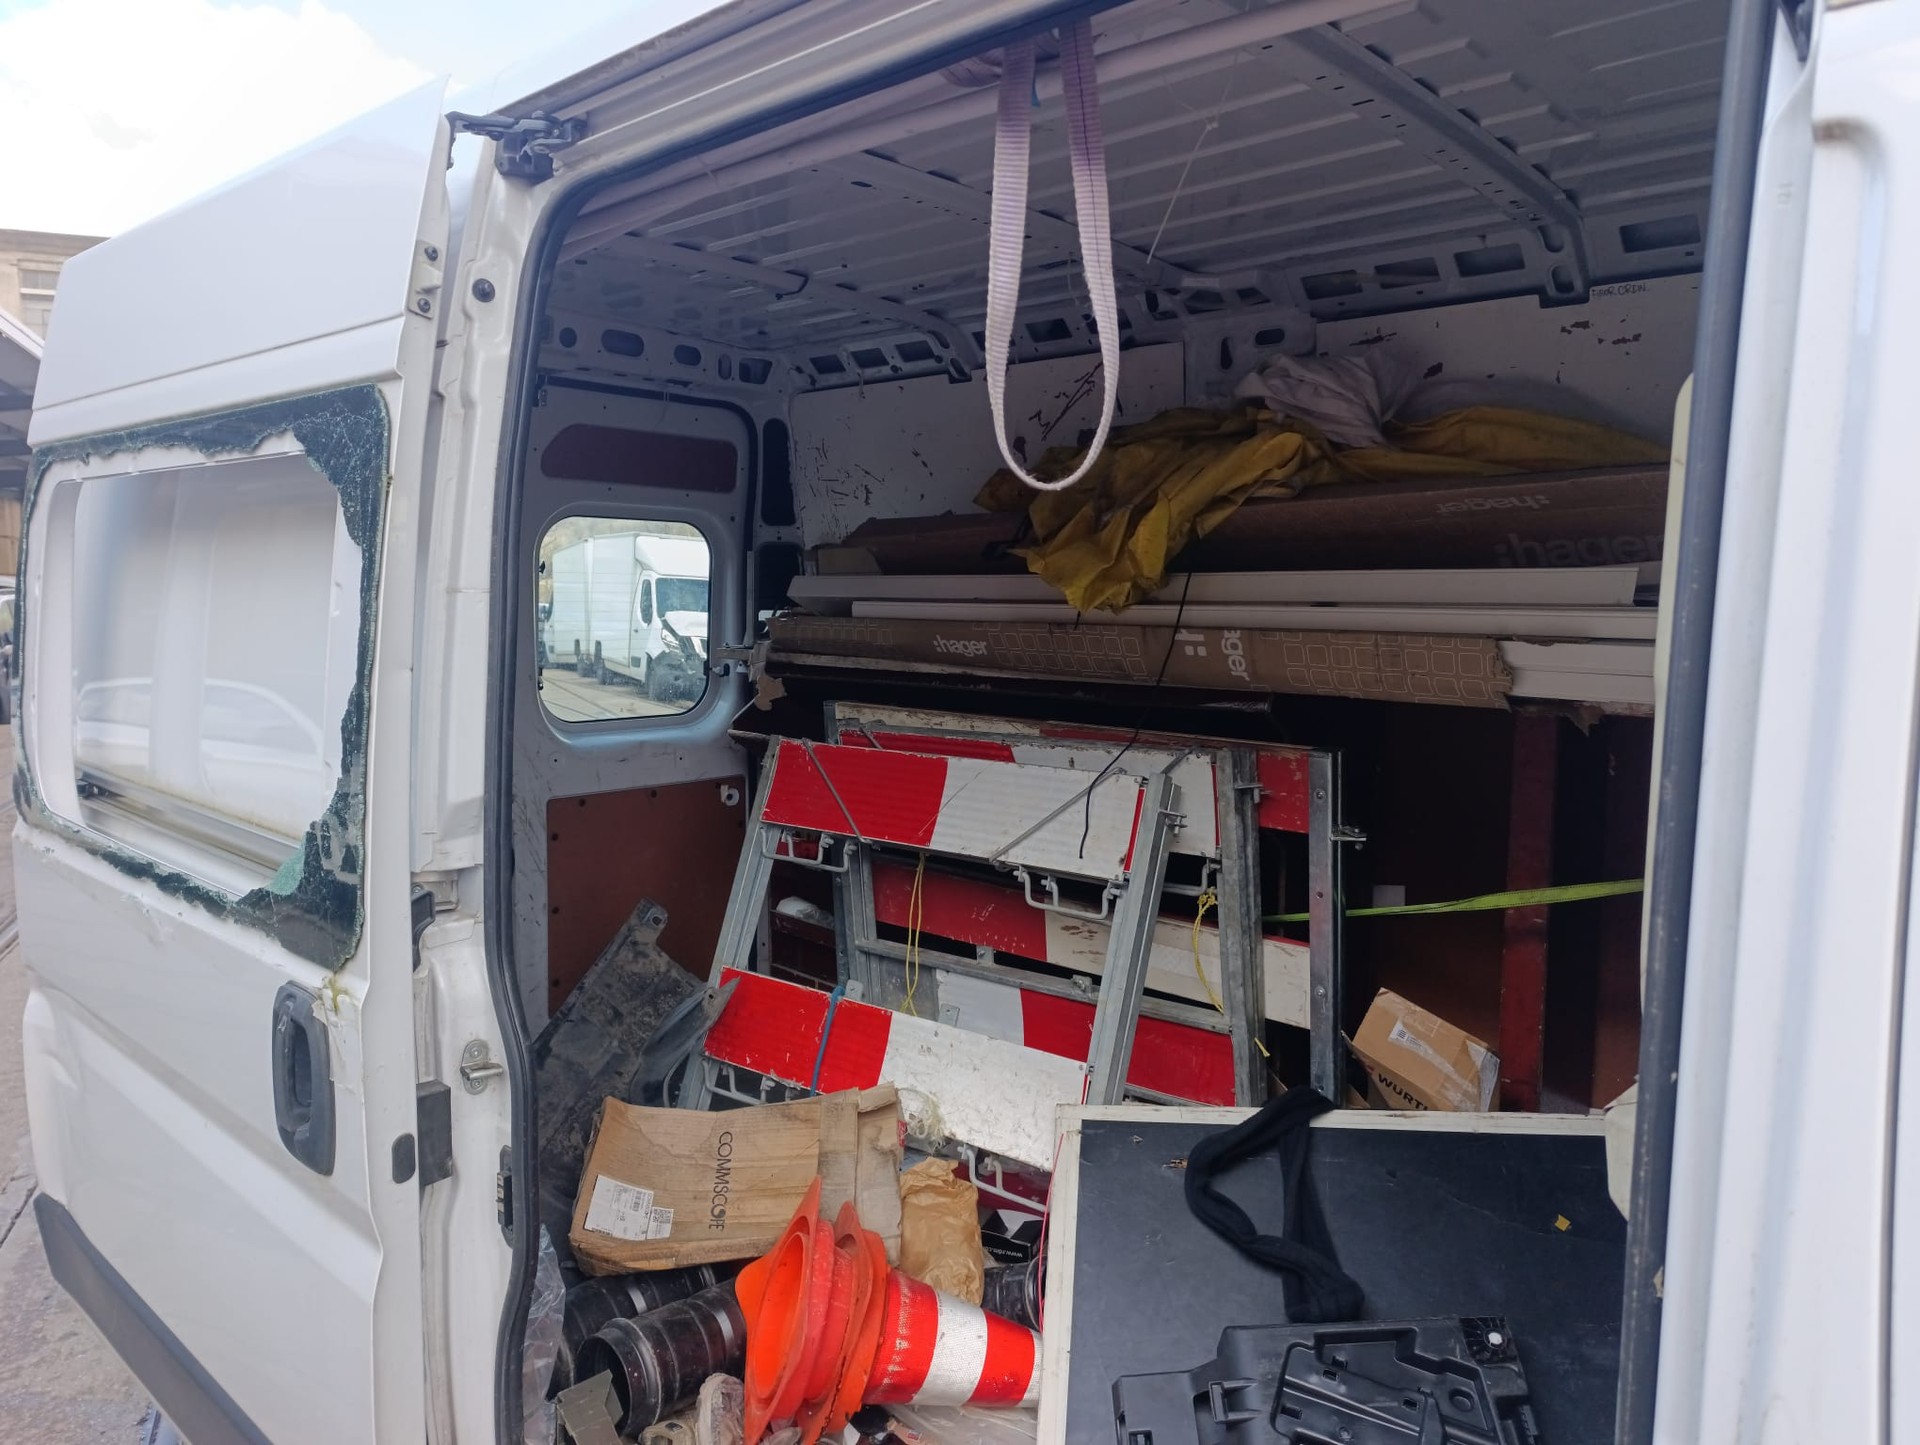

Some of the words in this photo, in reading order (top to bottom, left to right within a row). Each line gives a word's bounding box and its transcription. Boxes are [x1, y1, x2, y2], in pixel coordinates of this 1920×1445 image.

[1221, 629, 1250, 681] ager
[1378, 1073, 1429, 1111] WURT
[709, 1131, 733, 1232] COMMSCOPE
